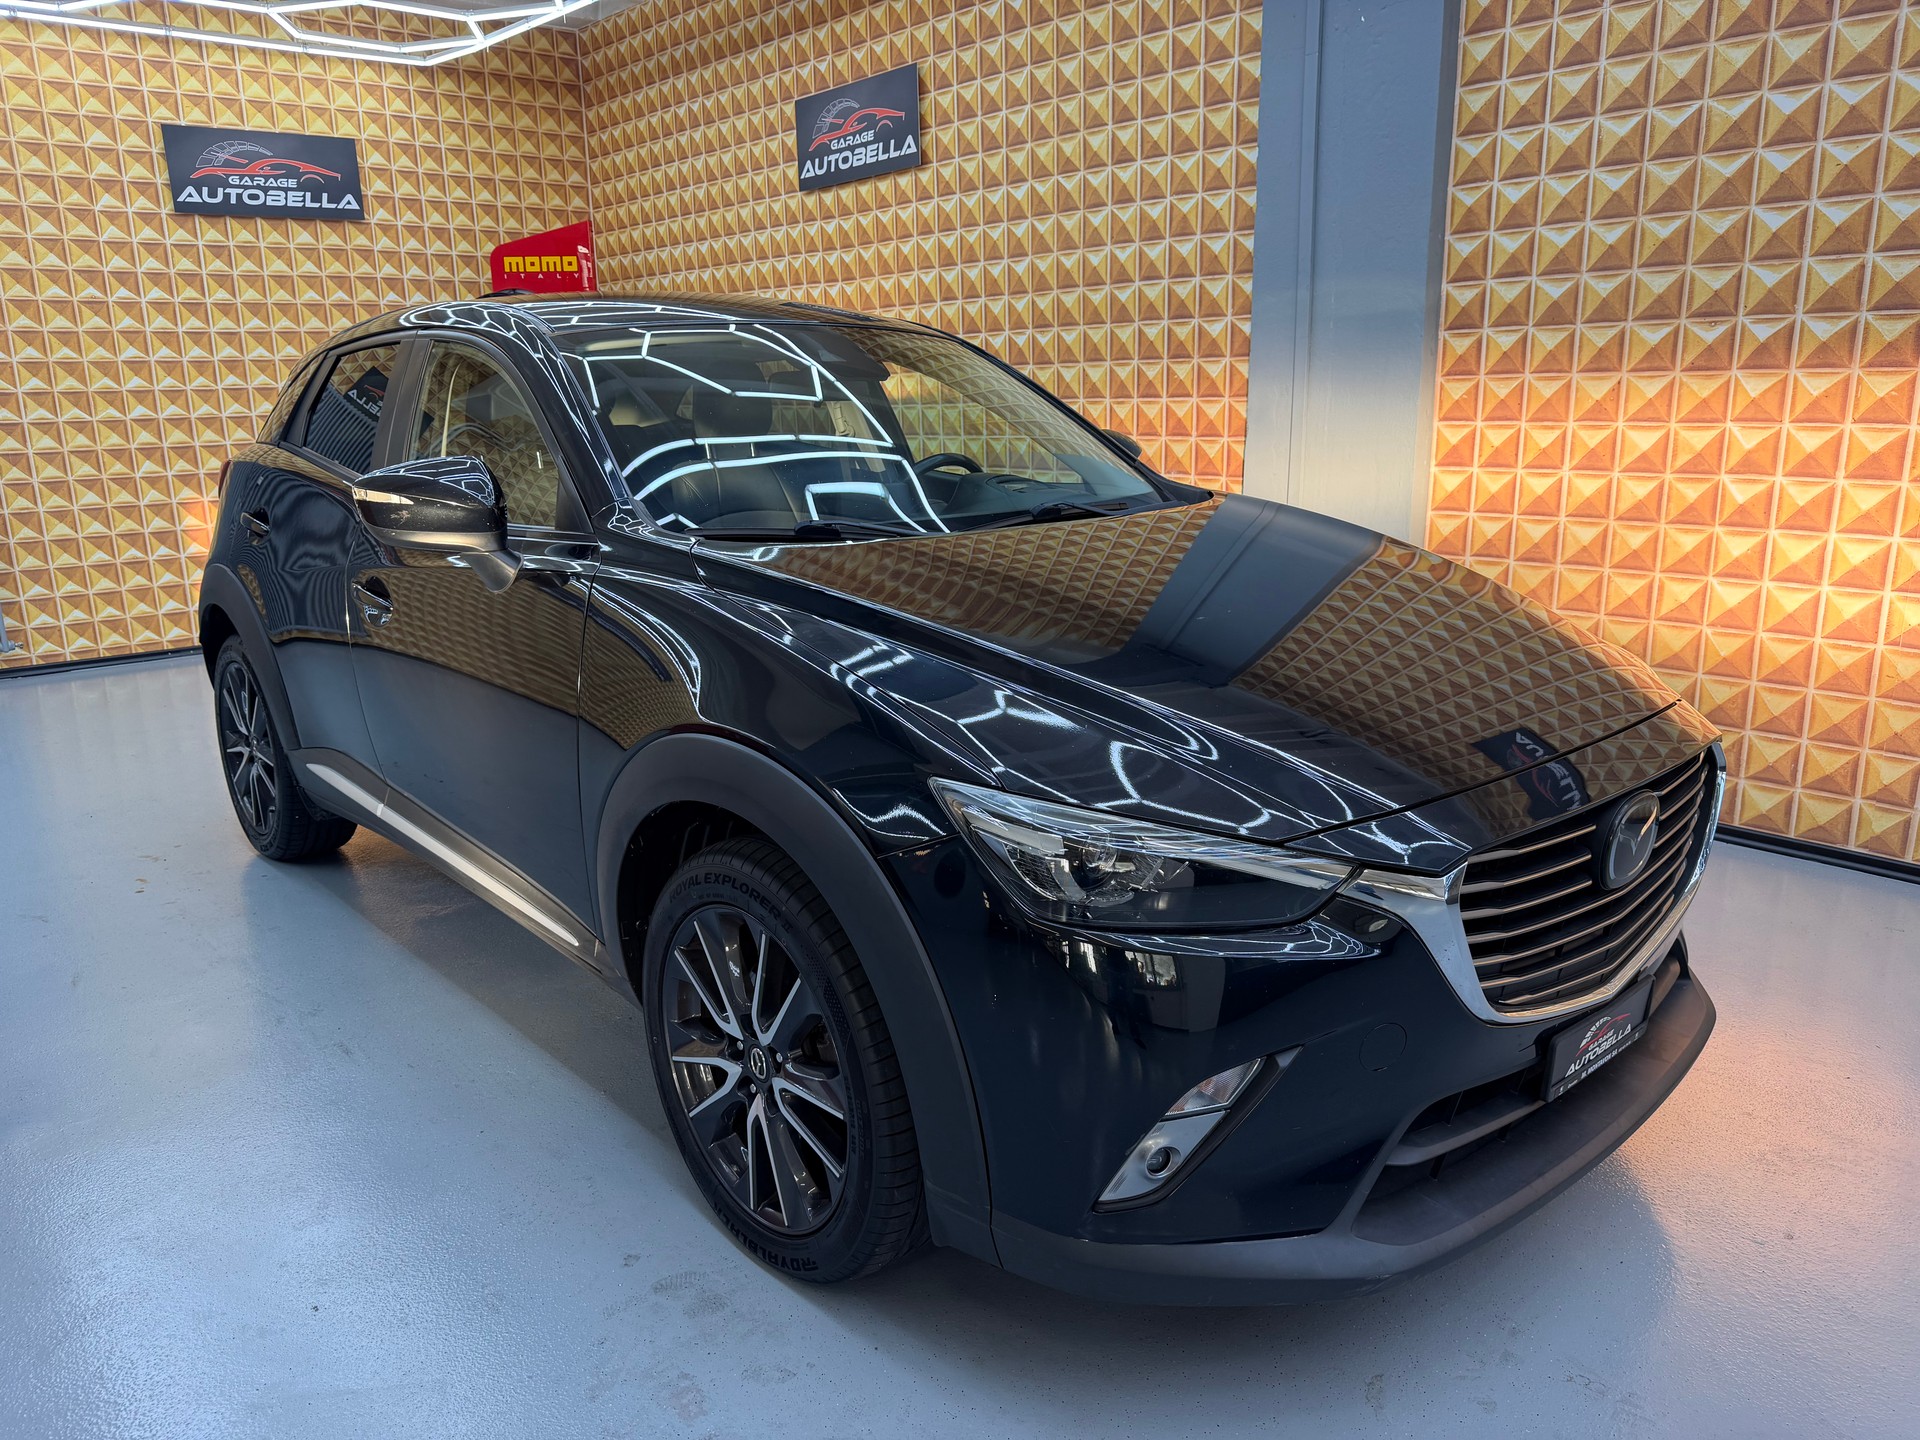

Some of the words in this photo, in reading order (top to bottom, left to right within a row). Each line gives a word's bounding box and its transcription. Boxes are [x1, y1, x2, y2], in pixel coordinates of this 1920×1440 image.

[830, 129, 875, 150] GARAGE
[800, 134, 918, 179] AUTOBELLA
[228, 175, 298, 188] GARAGE
[176, 185, 361, 210] AUTOBELLA
[669, 873, 701, 903] ROYAL
[704, 872, 782, 920] EXPLORER
[1565, 1023, 1632, 1078] AUTOBELLA
[1588, 1029, 1615, 1051] GARAGE
